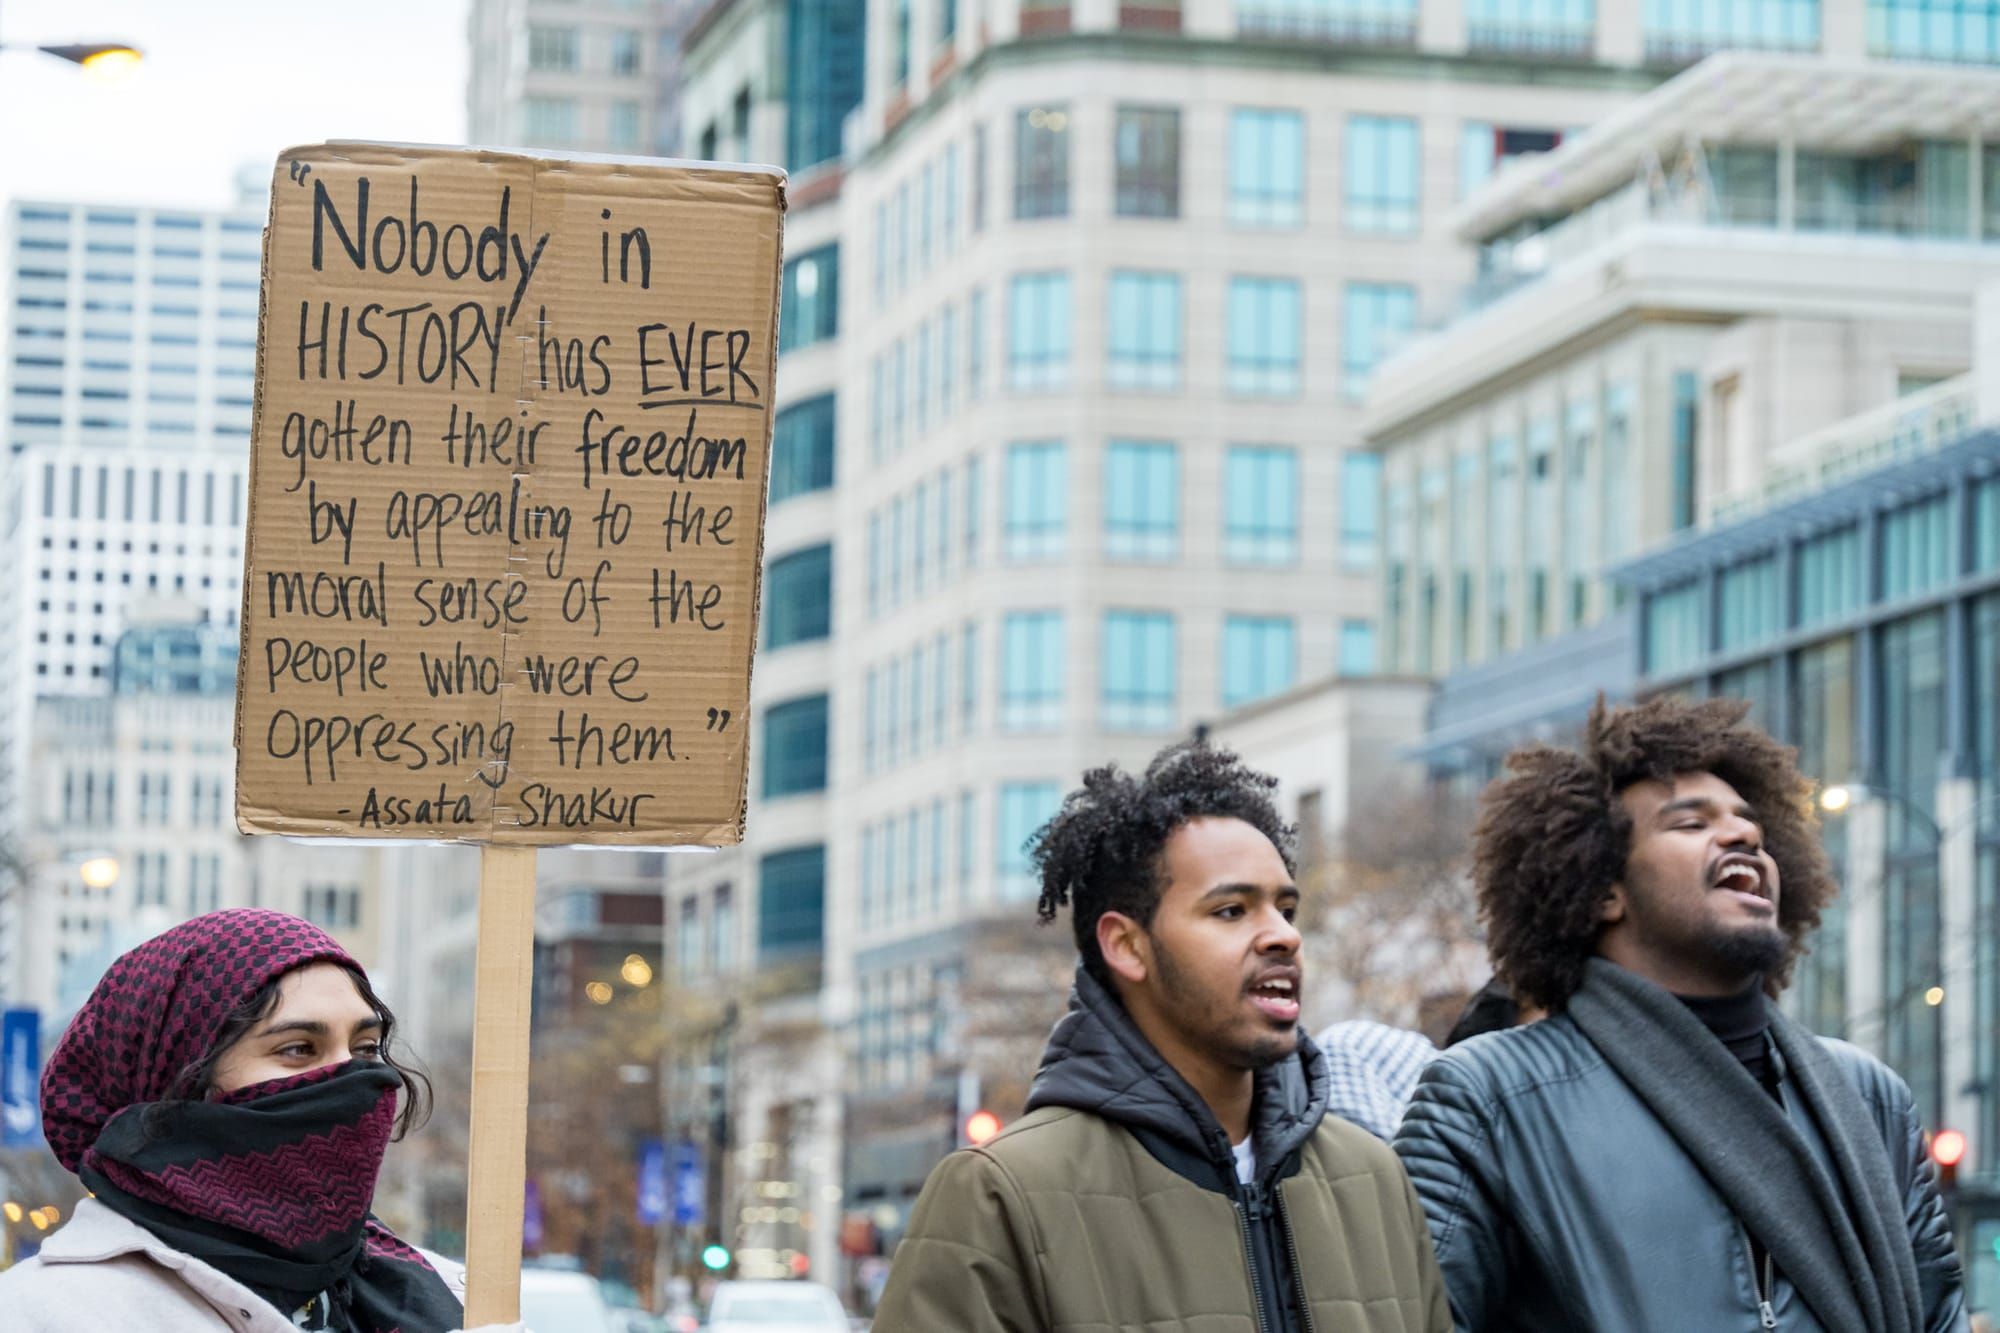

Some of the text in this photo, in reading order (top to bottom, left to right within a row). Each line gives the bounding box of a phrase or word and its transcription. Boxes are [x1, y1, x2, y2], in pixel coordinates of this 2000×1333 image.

[601, 209, 651, 289] in
[298, 301, 761, 403] HISTORY has EVER
[281, 400, 746, 492] gotten their freedom
[308, 479, 735, 579] by appealing to the
[267, 560, 725, 636] moral sense of the
[420, 641, 499, 698] who
[526, 654, 648, 702] were
